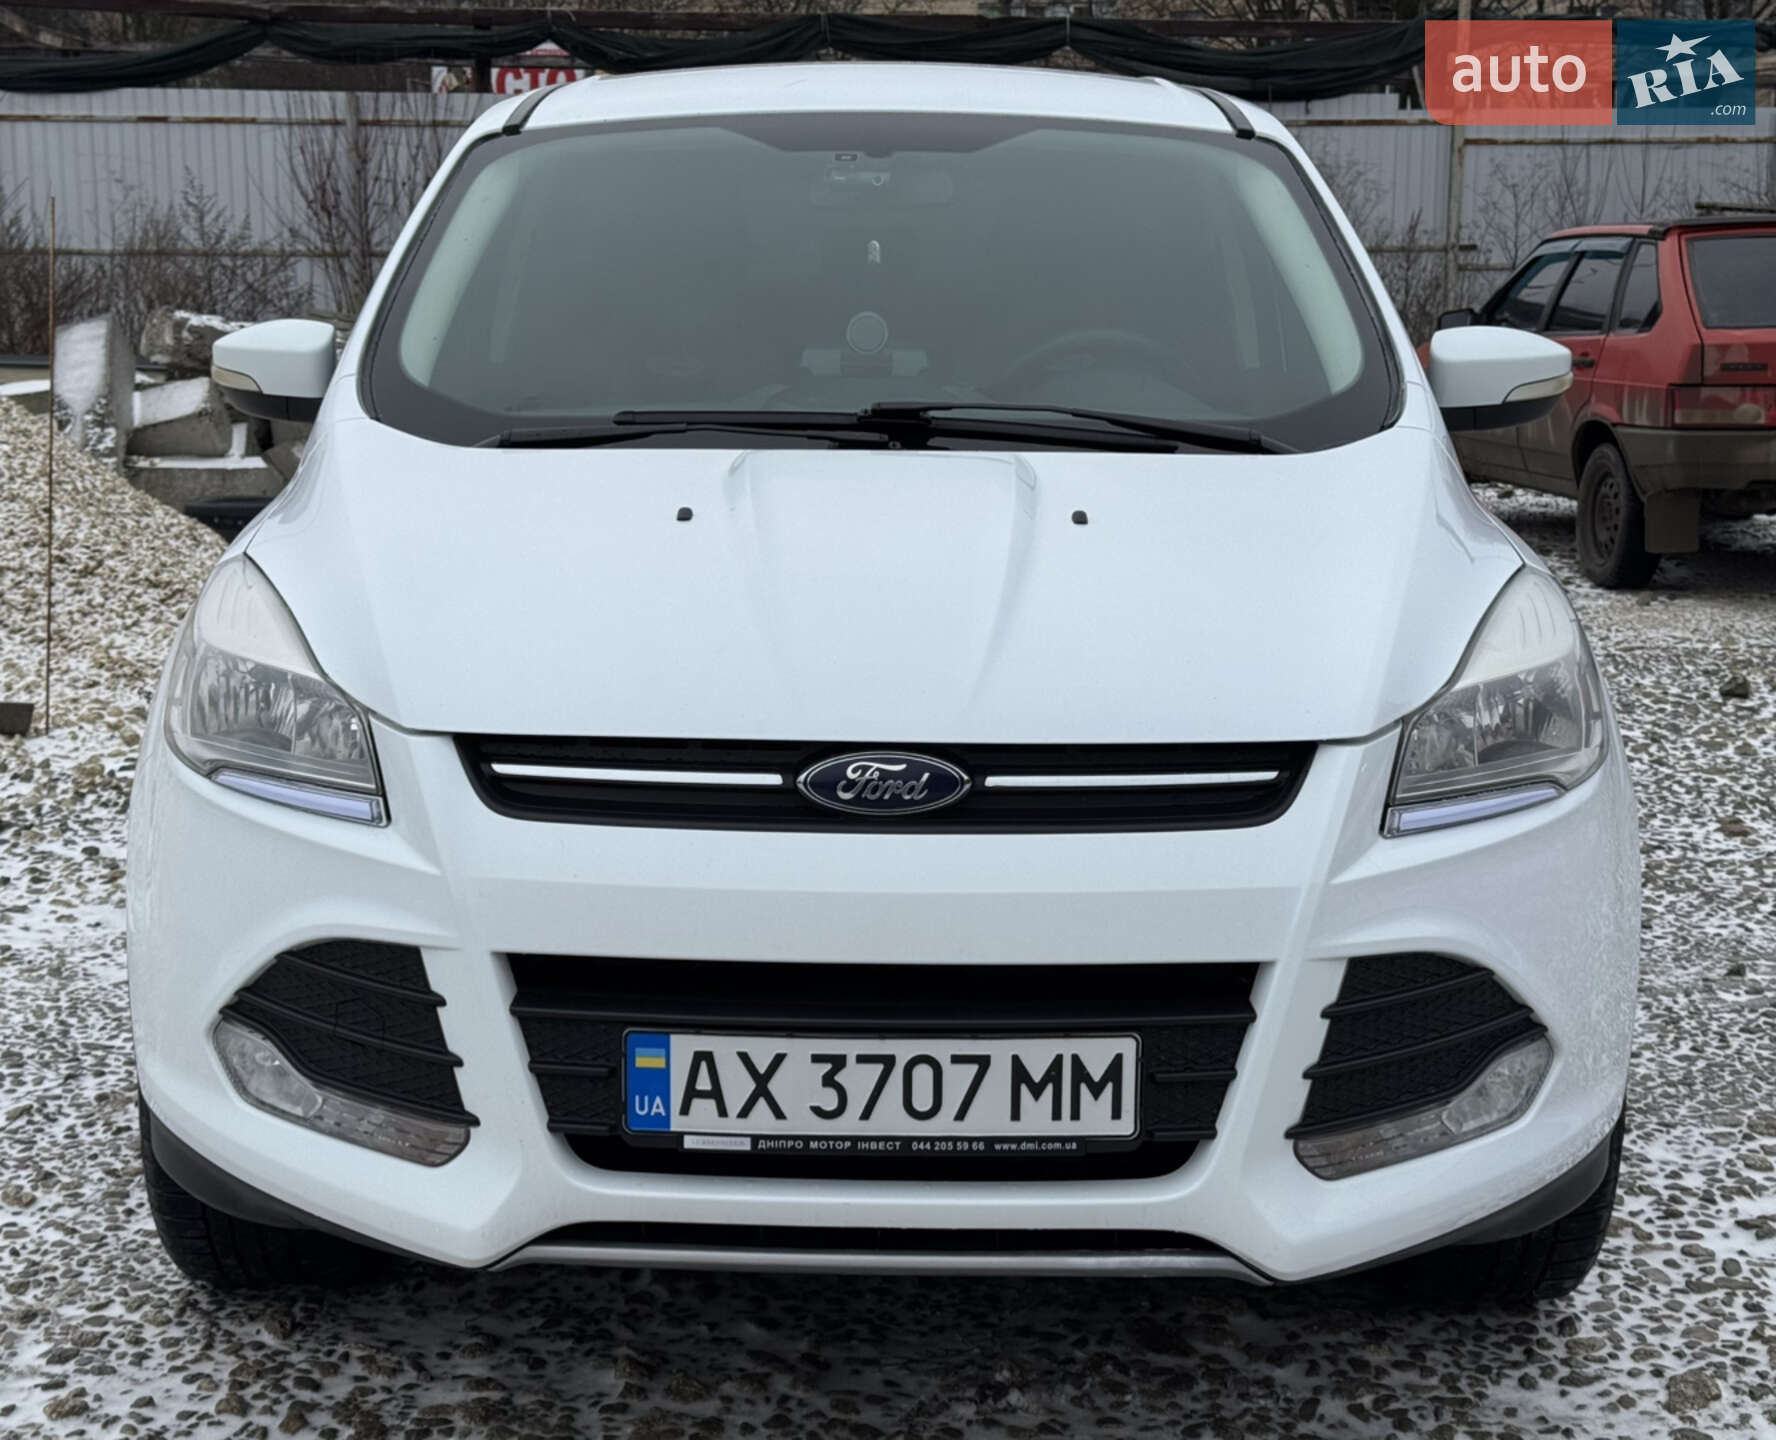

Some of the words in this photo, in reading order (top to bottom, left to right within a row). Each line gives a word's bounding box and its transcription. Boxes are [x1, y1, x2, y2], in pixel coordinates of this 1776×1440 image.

[836, 761, 930, 800] Ford
[808, 1053, 992, 1121] 3707
[1009, 1052, 1124, 1121] MM
[634, 1095, 666, 1117] UA
[757, 1139, 804, 1150] ДНІПРО
[809, 1140, 852, 1150] МОТОР
[857, 1141, 902, 1151] ІНВЕСТ
[911, 1141, 931, 1151] 044
[934, 1141, 953, 1151] 205
[956, 1141, 969, 1151] 59
